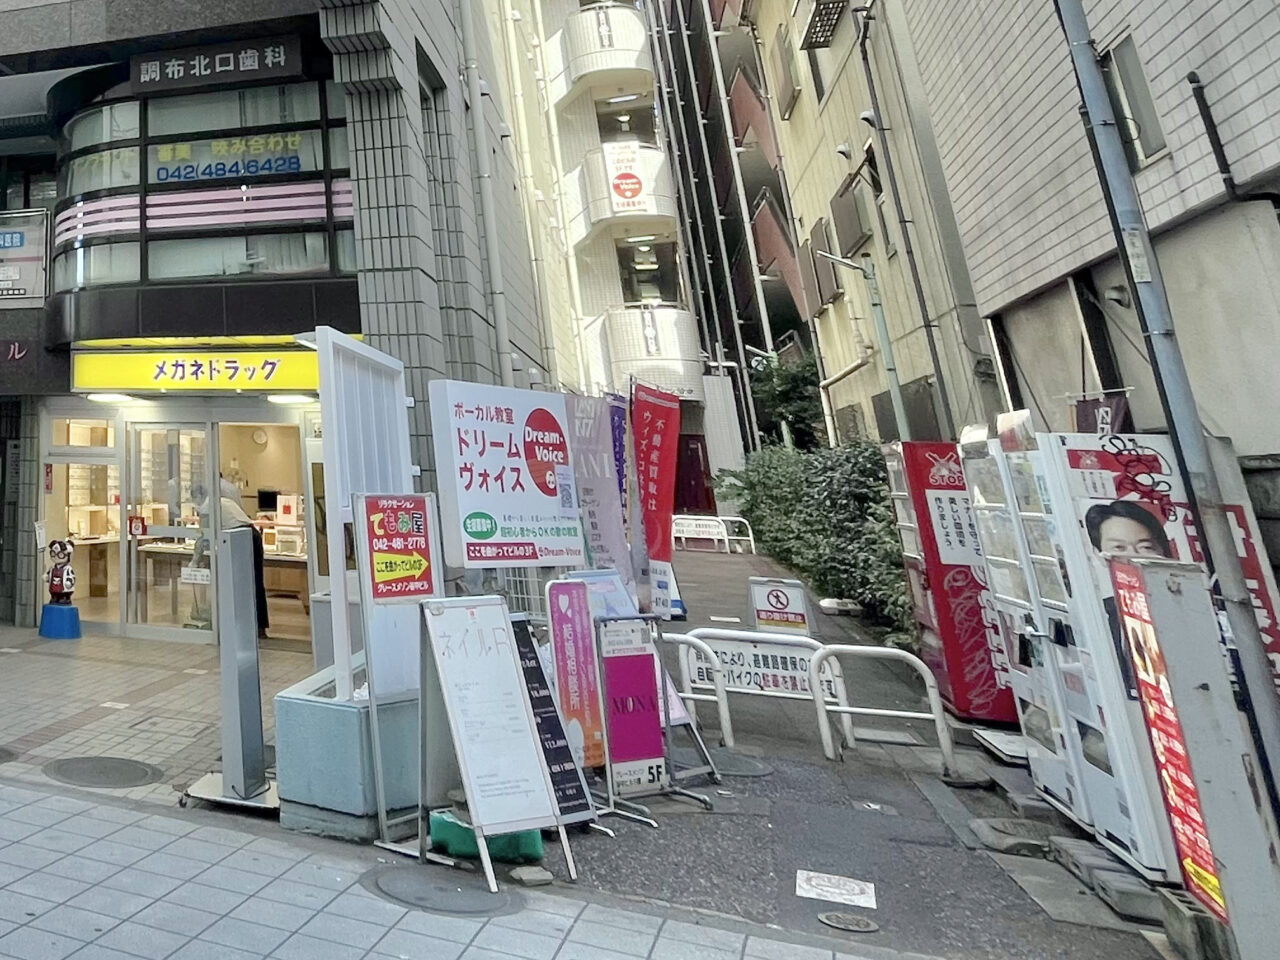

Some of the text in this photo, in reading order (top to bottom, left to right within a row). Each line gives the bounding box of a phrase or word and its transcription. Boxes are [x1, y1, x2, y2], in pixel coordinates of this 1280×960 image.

[140, 45, 286, 83] 調布北口歯科
[157, 156, 301, 181] 042(484)6428
[154, 359, 281, 380] メガネドラッグ
[454, 402, 514, 425] ボーカル教室
[457, 427, 521, 458] ドリーム
[535, 446, 564, 463] Voice
[459, 462, 525, 493] ヴォイス
[930, 474, 964, 486] STOP
[370, 510, 425, 536] てもみ屋
[648, 765, 662, 784] 5F
